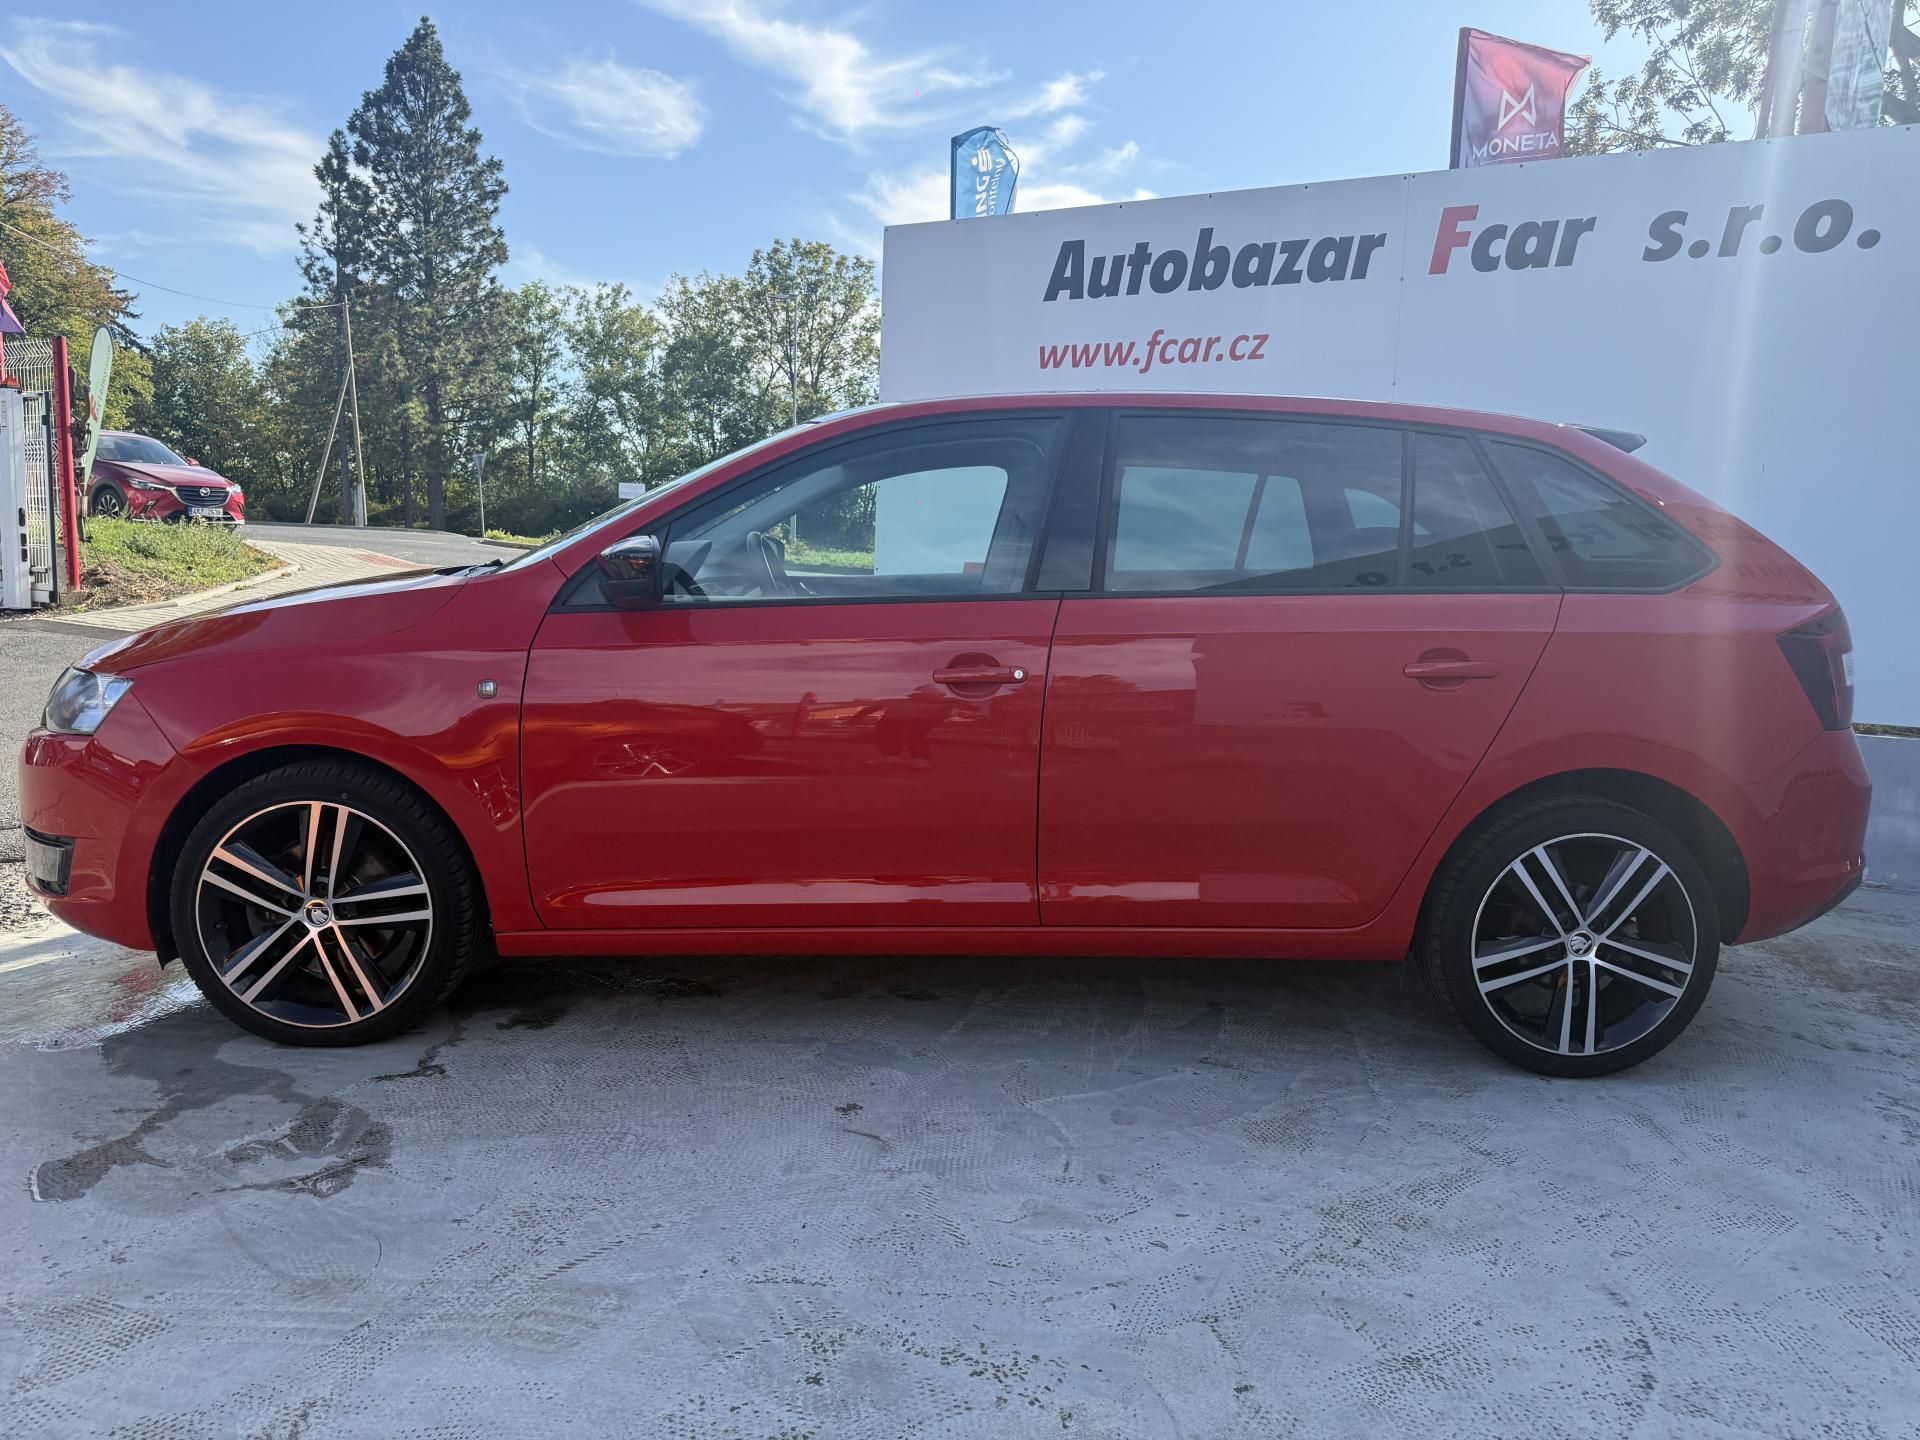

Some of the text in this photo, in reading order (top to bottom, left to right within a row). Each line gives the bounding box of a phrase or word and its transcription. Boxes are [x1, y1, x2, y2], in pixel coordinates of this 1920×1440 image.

[1472, 131, 1559, 160] MONETA
[1043, 198, 1882, 302] Autobazar Fcar s.r.o.
[1039, 329, 1270, 374] www.fcar.cz
